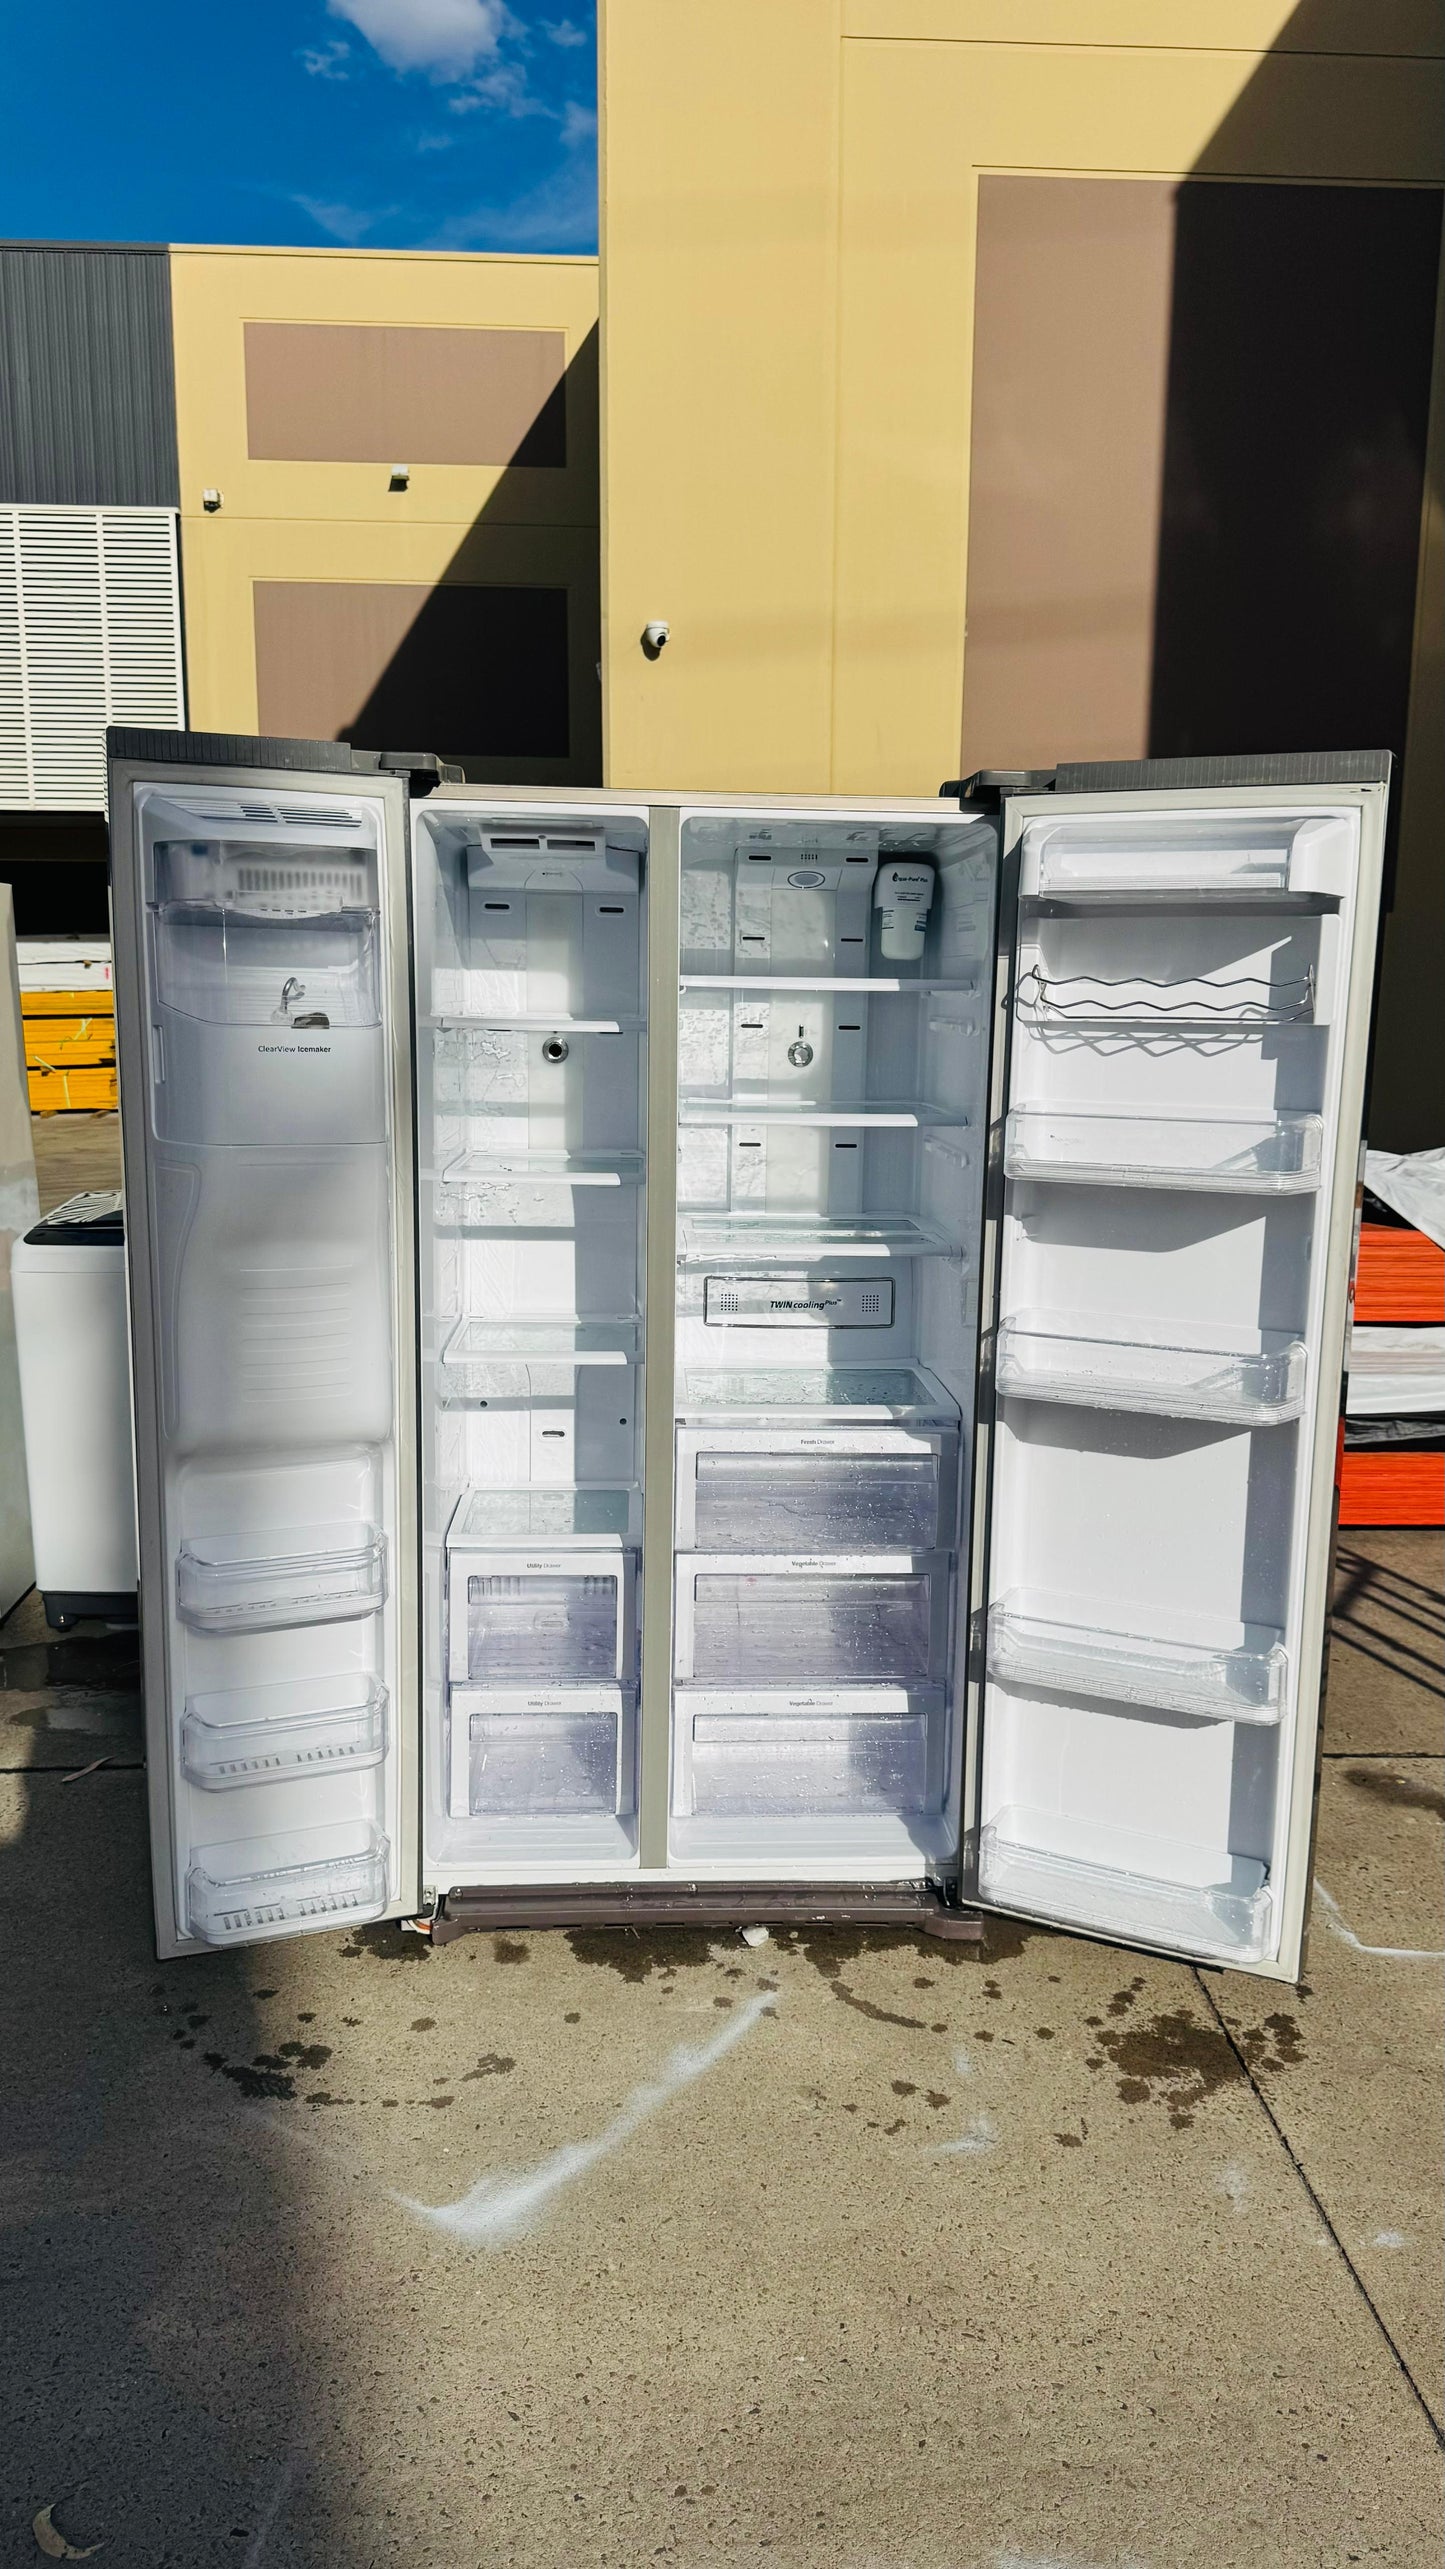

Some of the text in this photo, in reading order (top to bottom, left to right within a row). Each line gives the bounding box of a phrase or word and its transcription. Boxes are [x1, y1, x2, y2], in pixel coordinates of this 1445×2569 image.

[258, 1045, 332, 1053] ClearView Icemaker
[770, 1300, 793, 1309] TWIN
[791, 1560, 819, 1568] Vegetable
